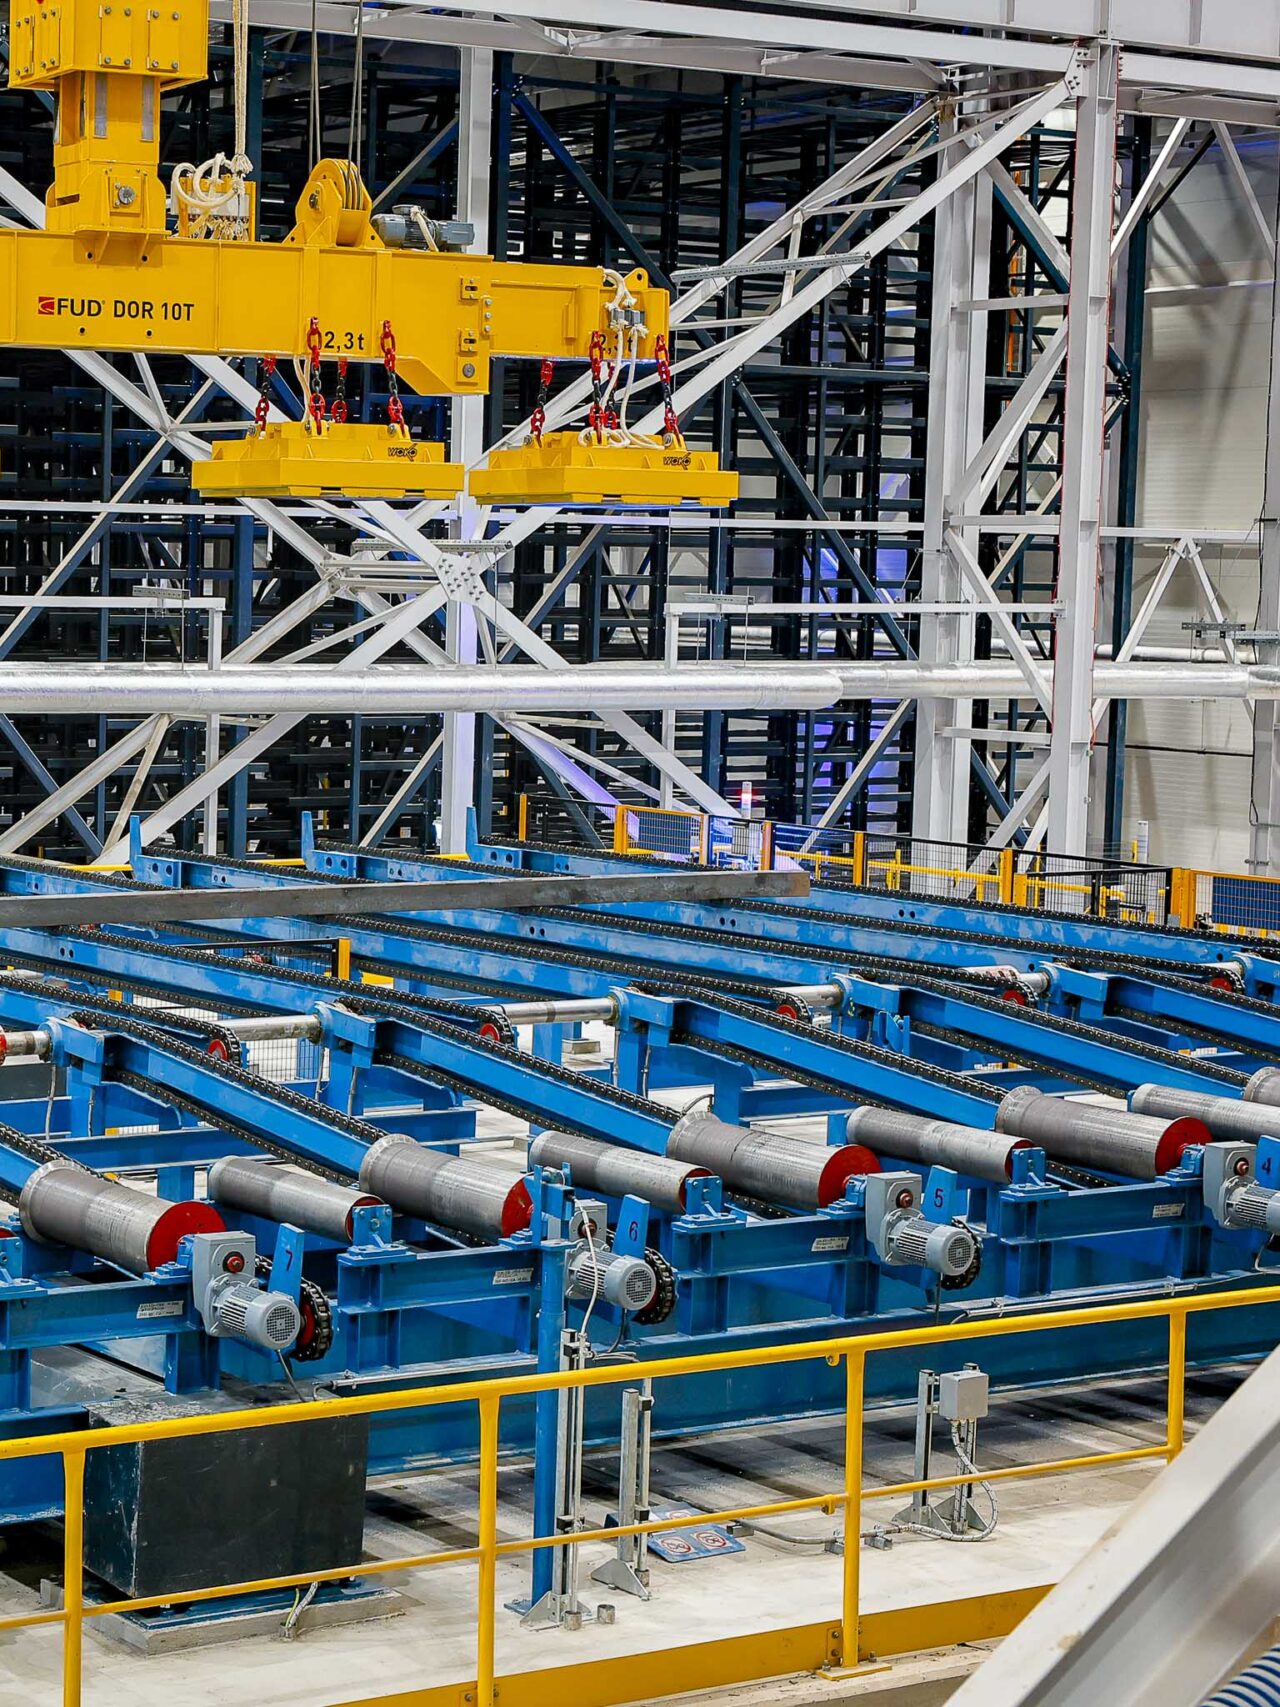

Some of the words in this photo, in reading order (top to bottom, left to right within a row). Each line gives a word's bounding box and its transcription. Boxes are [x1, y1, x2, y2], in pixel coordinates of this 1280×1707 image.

[113, 299, 154, 319] DOR
[161, 302, 195, 321] 10T
[324, 331, 365, 352] 2,3t
[934, 1187, 944, 1208] 5
[629, 1220, 639, 1242] 6
[285, 1248, 293, 1271] 7
